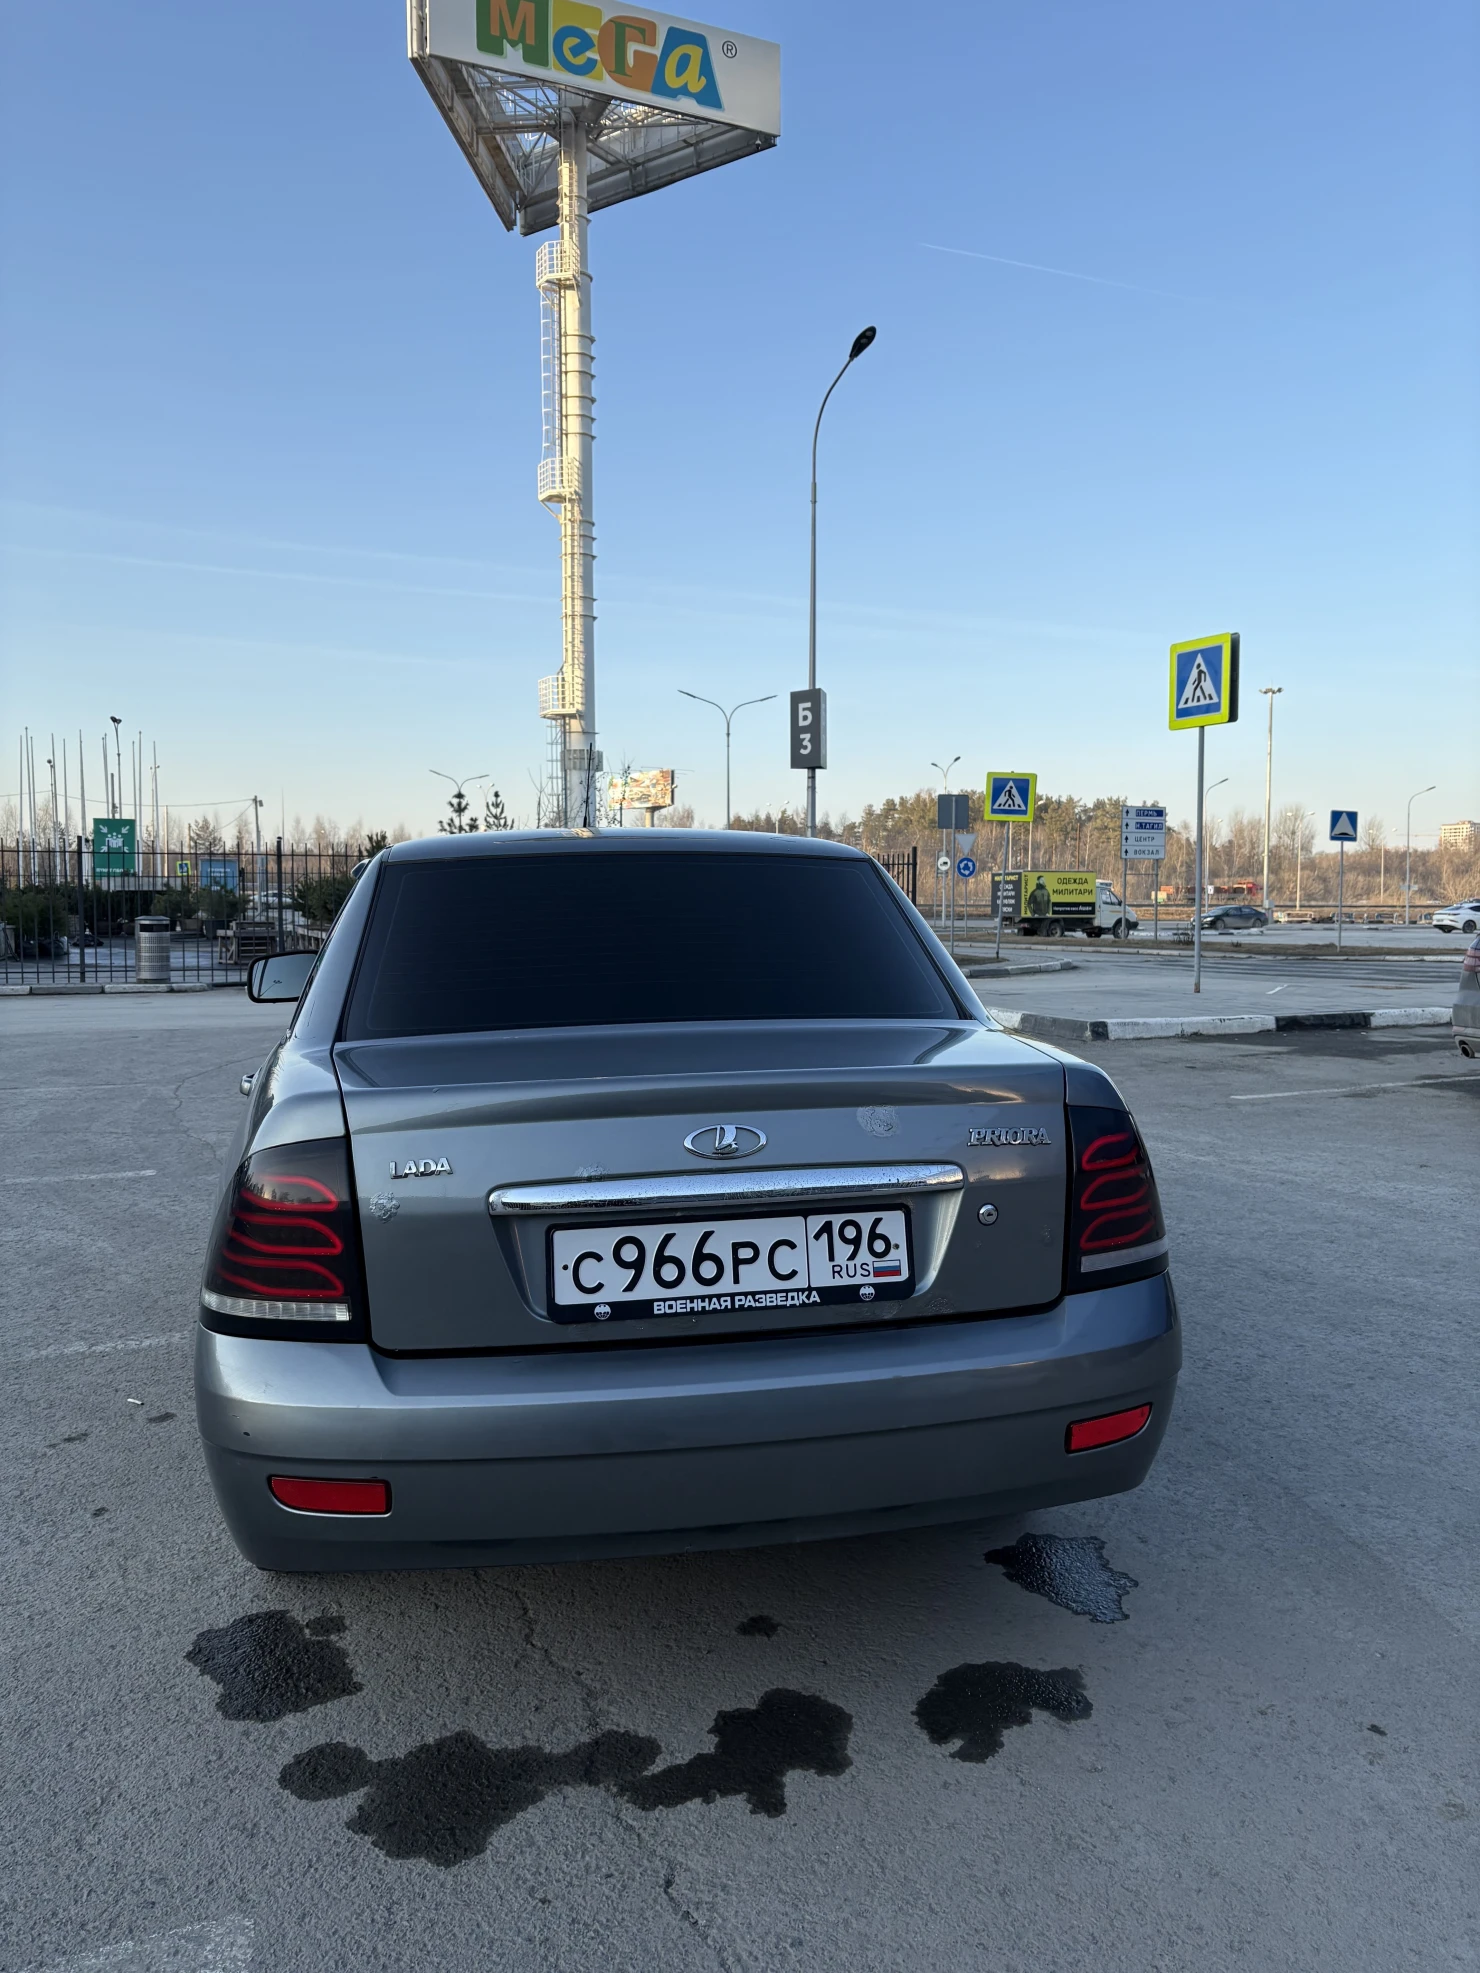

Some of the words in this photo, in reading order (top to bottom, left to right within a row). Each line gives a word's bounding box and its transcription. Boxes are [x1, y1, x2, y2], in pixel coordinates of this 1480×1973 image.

[798, 702, 812, 727] Б
[799, 733, 812, 755] 3
[1052, 888, 1093, 896] МИЛИТАРИ
[967, 1127, 1051, 1147] PRIORA
[389, 1157, 453, 1179] LADA
[812, 1217, 892, 1263] 196
[832, 1262, 871, 1280] RUS
[653, 1295, 732, 1315] ВОЕННАЯ
[735, 1290, 821, 1309] РАЗВЕДКА
